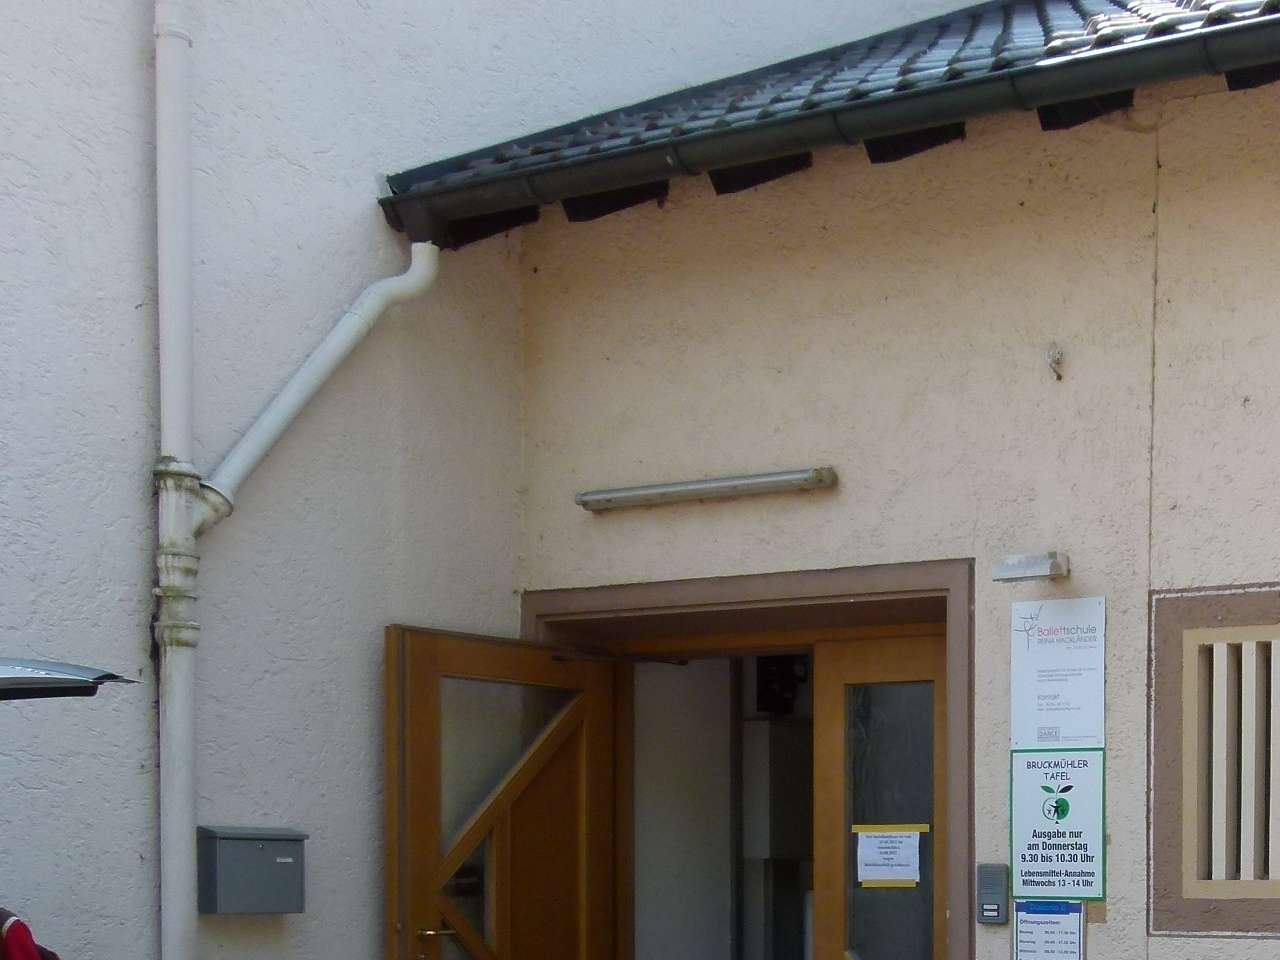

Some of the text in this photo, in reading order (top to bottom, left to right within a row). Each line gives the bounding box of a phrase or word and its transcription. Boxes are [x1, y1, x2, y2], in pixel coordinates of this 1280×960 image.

[1037, 624, 1097, 637] Ballettschule
[1026, 758, 1089, 770] BRUCKMÜHLER
[1043, 771, 1071, 781] TAFEL
[1032, 829, 1083, 841] Ausgabe nur
[1027, 841, 1088, 852] am Donnerstag
[1021, 853, 1095, 863] 9.30 bis 10.30 Uhr
[1020, 869, 1096, 878] Lebensmittel-Annahme
[1022, 878, 1056, 887] Mittwochs
[1058, 879, 1066, 887] 13
[1072, 879, 1081, 887] 14
[1082, 879, 1094, 887] Uhr
